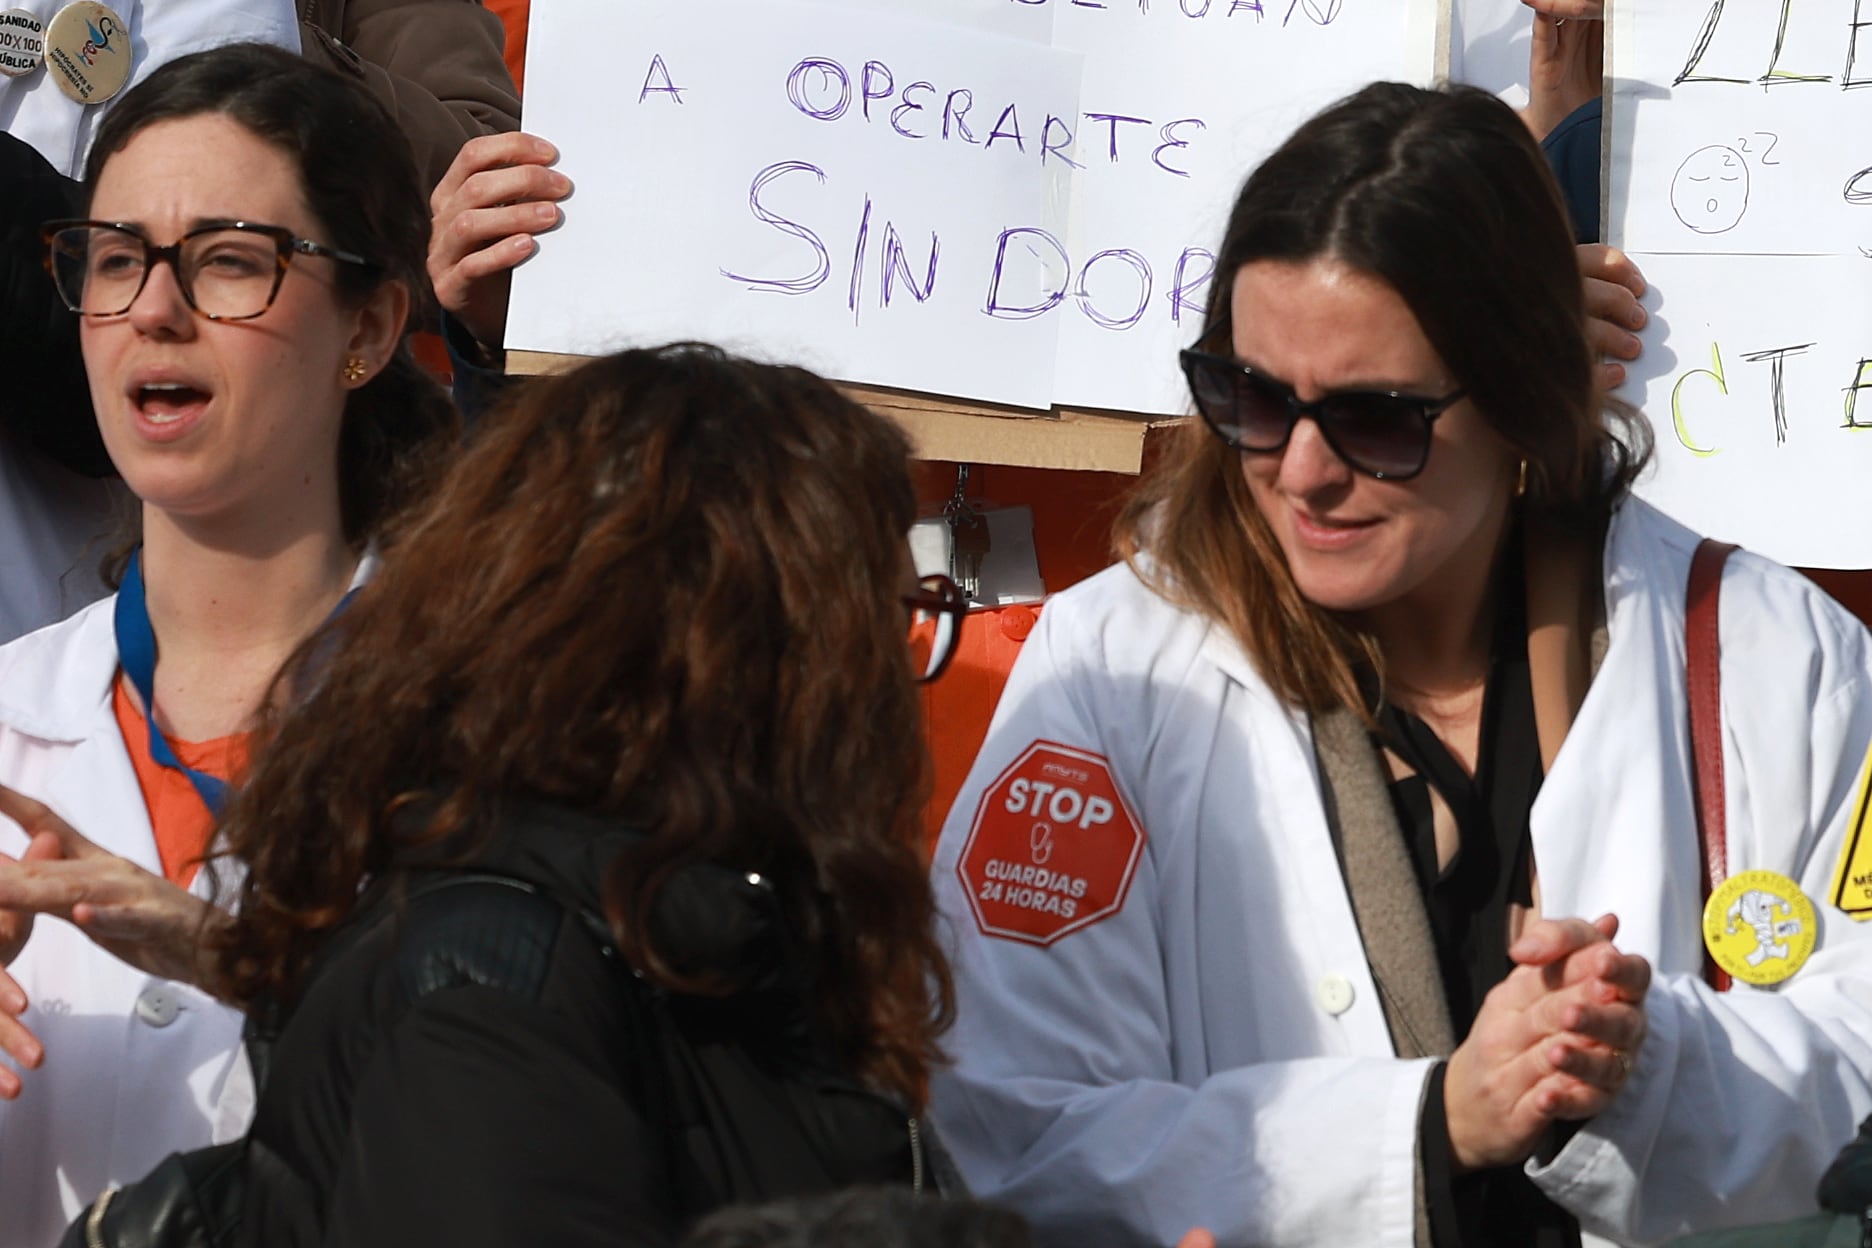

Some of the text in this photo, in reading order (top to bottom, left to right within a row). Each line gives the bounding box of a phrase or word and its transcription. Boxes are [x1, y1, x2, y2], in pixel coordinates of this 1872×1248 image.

[0, 15, 41, 33] SANIDAD
[0, 52, 36, 69] ÚBLICA
[638, 53, 1207, 178] A OPERARTE
[719, 160, 1217, 330] SIN DOR
[1005, 777, 1114, 830] STOP
[985, 859, 1088, 899] GUARDIAS
[979, 882, 1077, 919] 24 HORAS
